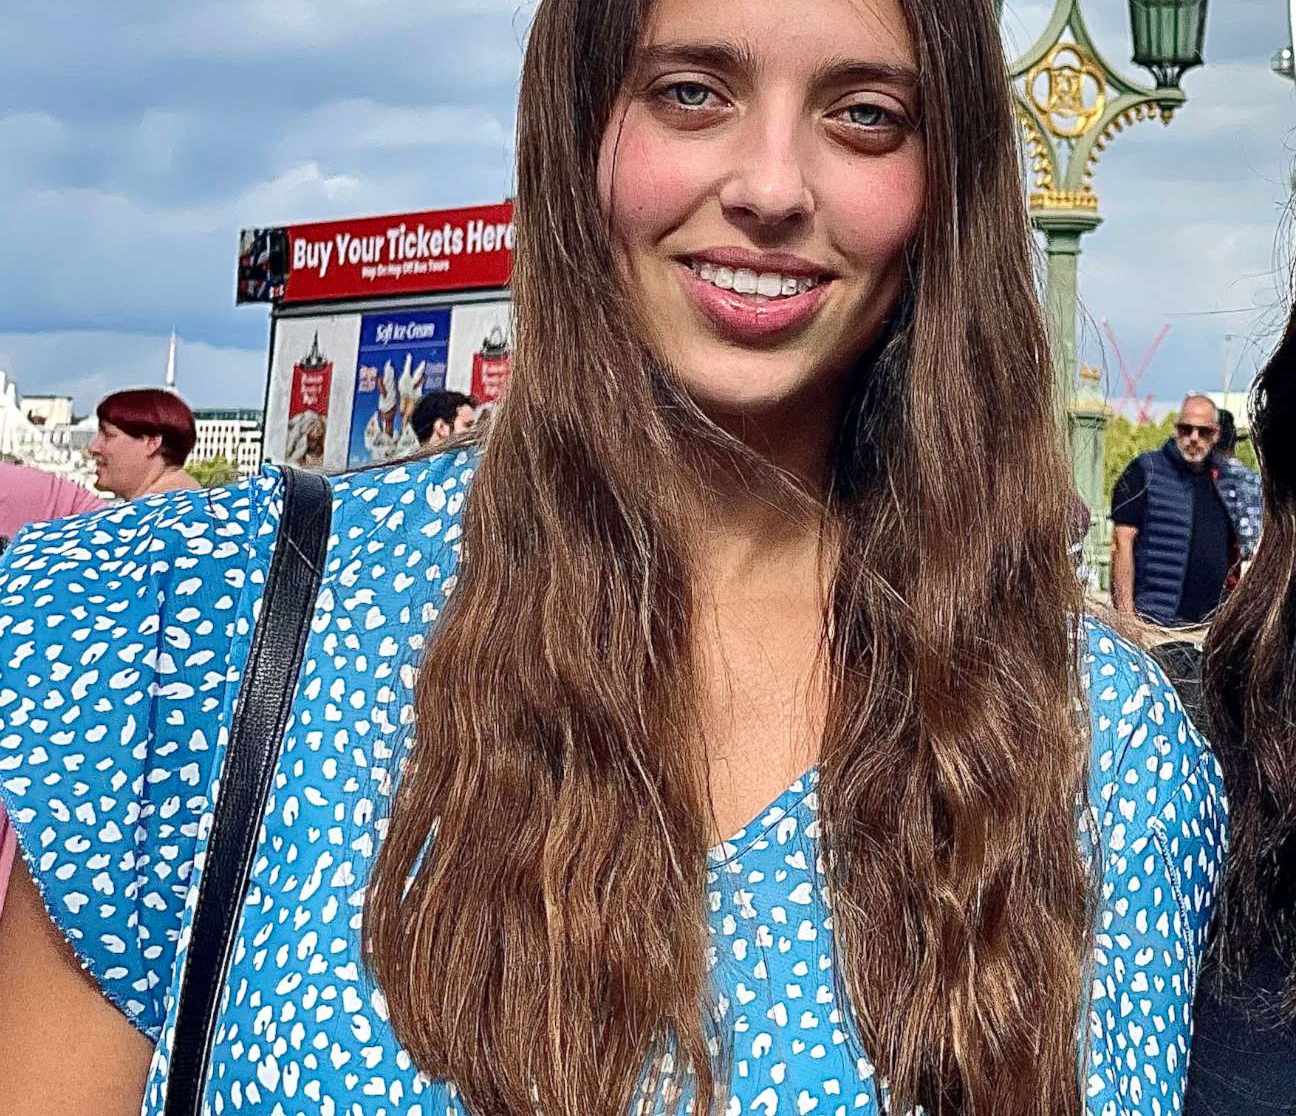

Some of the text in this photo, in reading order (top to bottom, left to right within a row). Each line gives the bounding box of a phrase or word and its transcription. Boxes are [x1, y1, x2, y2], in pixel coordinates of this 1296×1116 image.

[293, 237, 333, 278] Buy
[336, 232, 385, 266] Your
[386, 222, 464, 261] Tickets
